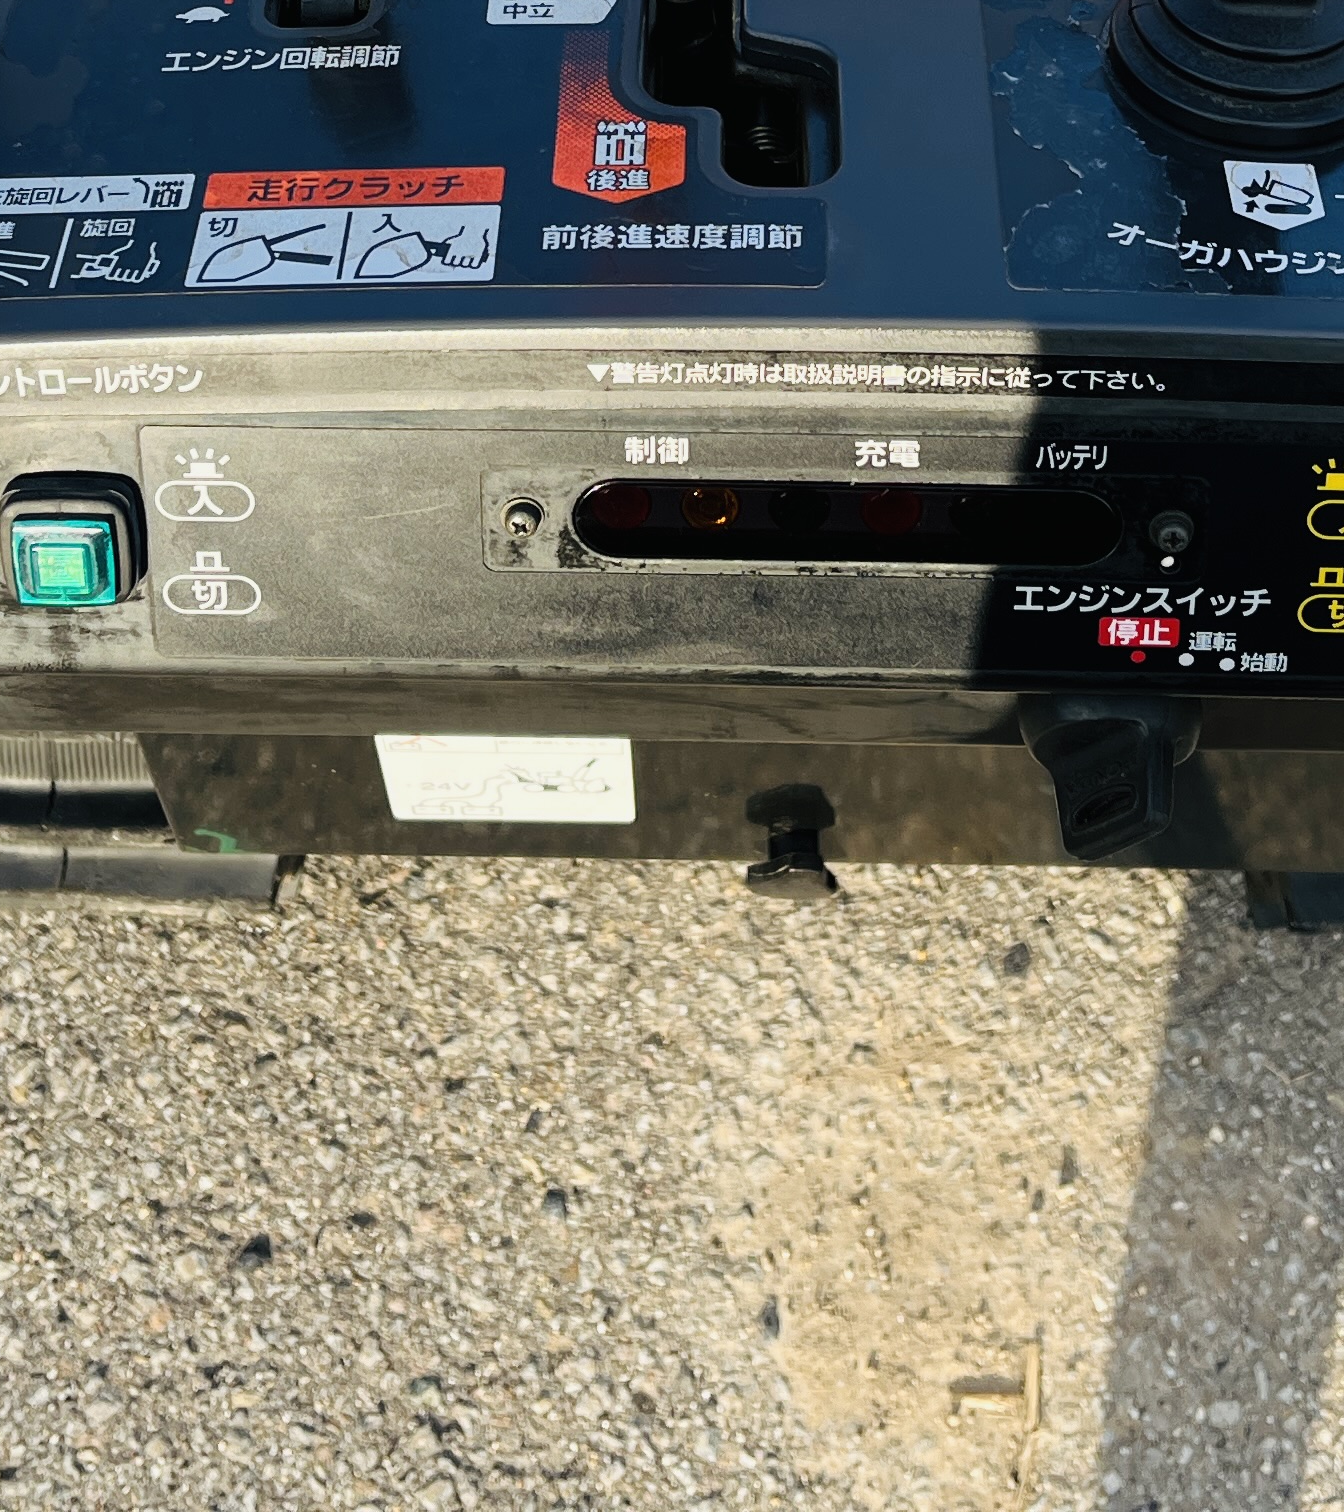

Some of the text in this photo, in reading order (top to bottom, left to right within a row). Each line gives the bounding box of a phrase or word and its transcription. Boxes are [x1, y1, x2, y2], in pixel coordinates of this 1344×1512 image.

[502, 1, 556, 20] 中立
[160, 41, 402, 73] エンジン回転調節
[246, 173, 465, 202] 走行クラッチ
[584, 166, 651, 193] 後進
[79, 217, 136, 239] 旋回
[207, 212, 402, 238] 切 入
[541, 223, 804, 252] 前後進速度調節
[609, 362, 1169, 391] 警告灯点灯時は取扱説明書の指示に従って下さい。
[623, 436, 690, 466] 制御
[854, 438, 922, 469] 充電
[1035, 443, 1109, 471] バッテリ
[185, 484, 225, 517] 入
[189, 579, 229, 612] 切
[1013, 583, 1273, 617] エンジンスイッチ
[1107, 618, 1172, 647] 停止
[1187, 630, 1238, 653] 運転
[1240, 651, 1288, 674] 始動
